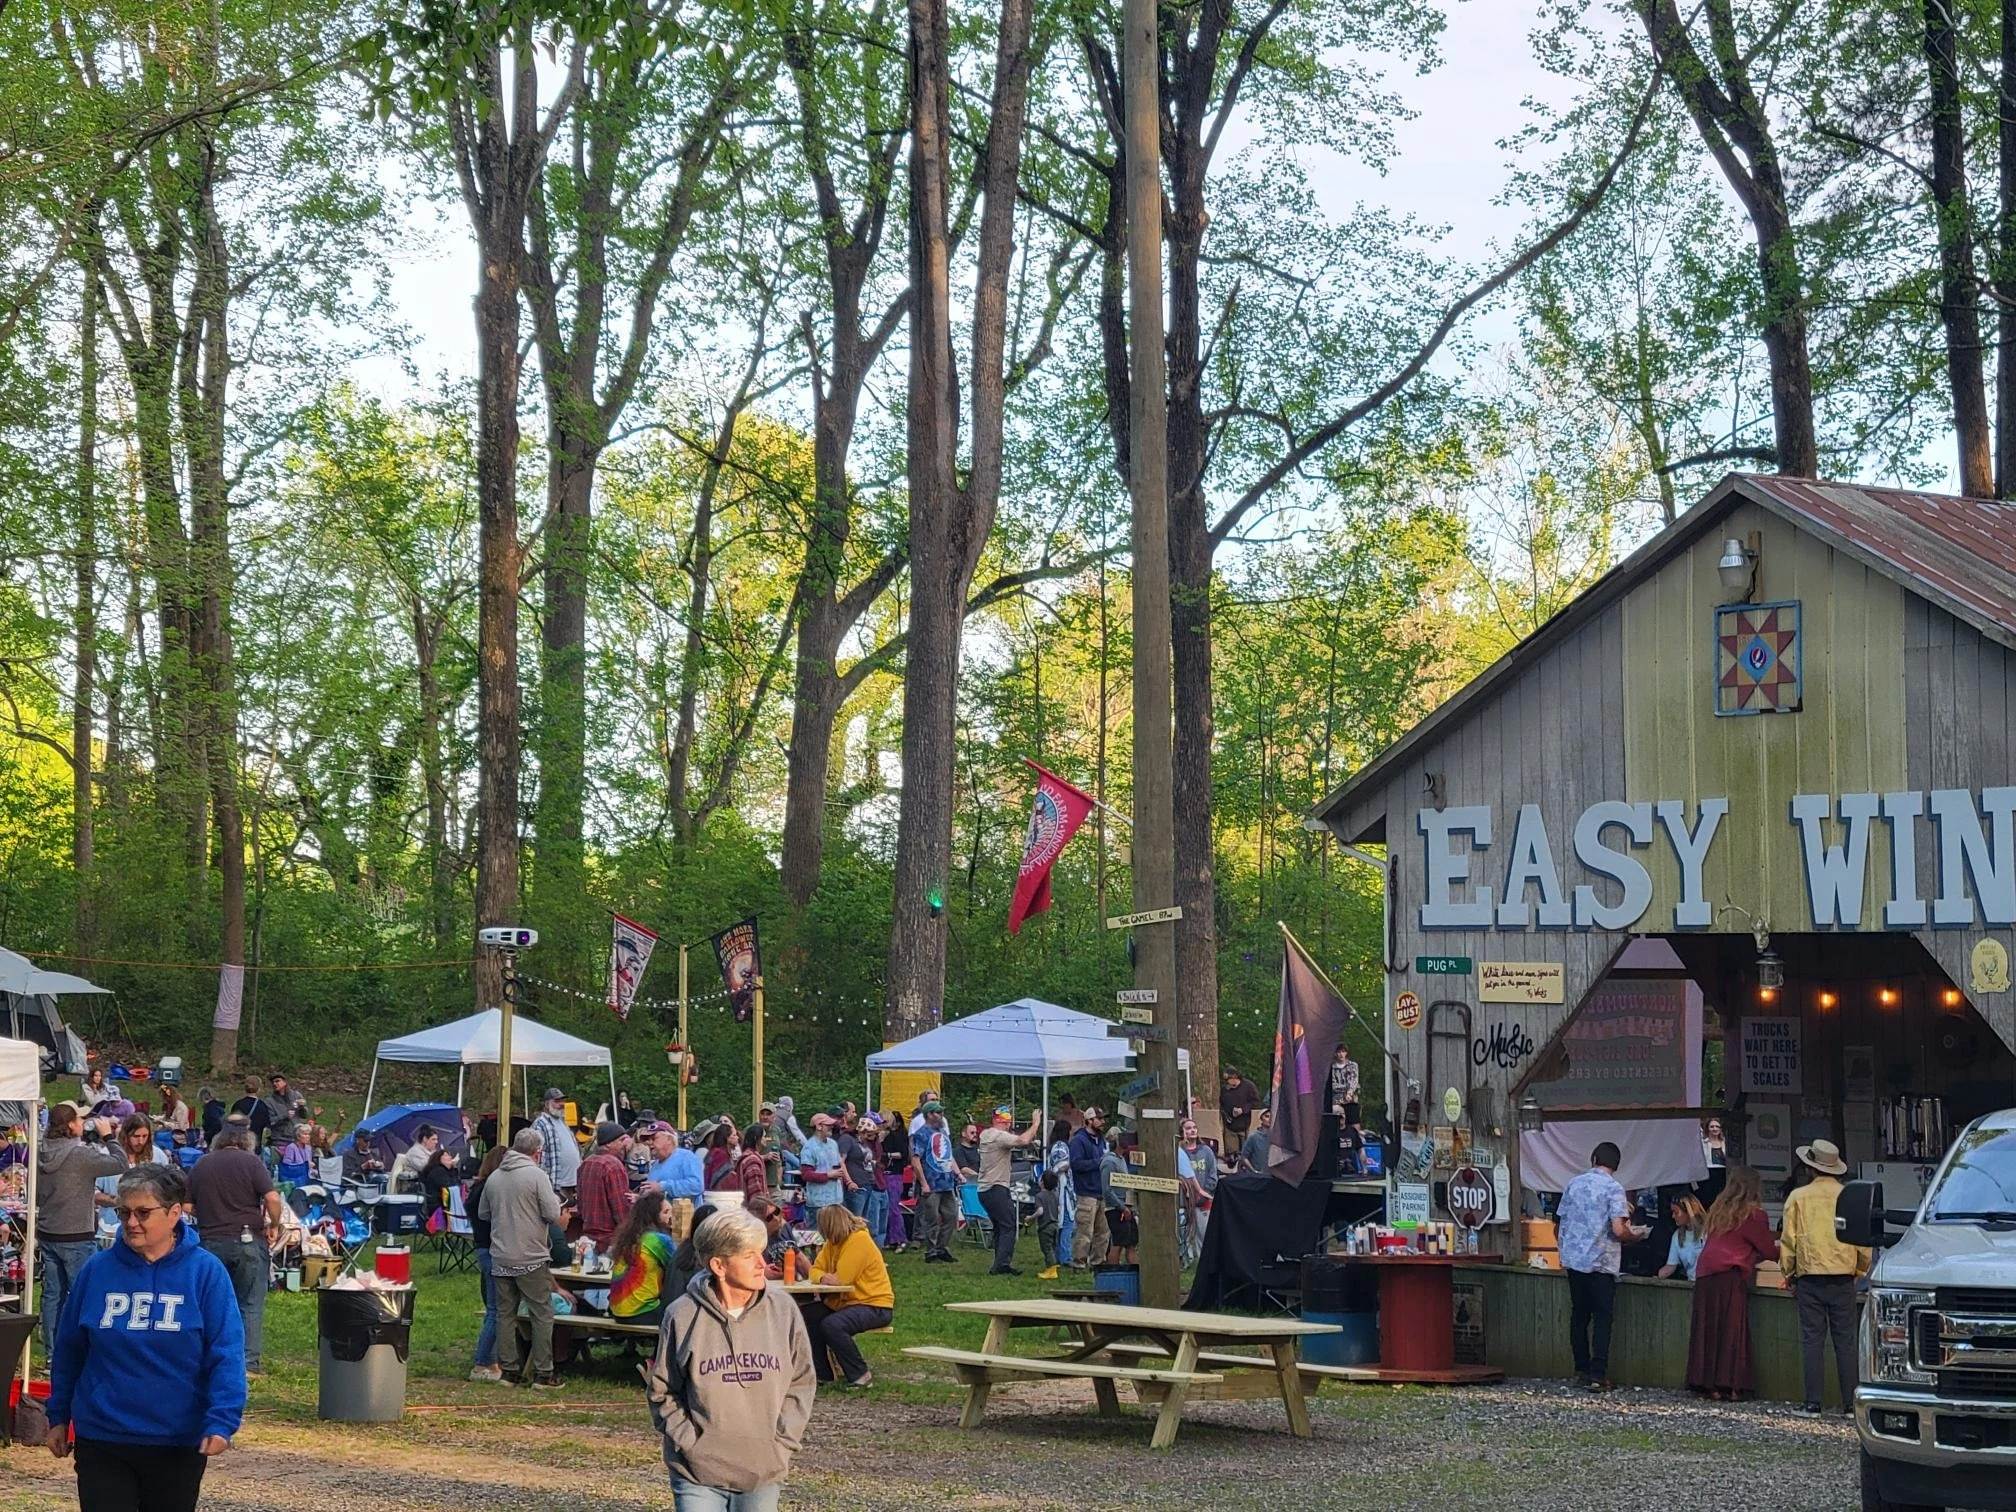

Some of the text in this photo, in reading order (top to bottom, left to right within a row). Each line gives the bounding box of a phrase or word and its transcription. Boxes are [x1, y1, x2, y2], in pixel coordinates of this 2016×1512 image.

[1053, 792, 1068, 824] FARM
[1035, 829, 1067, 867] VIRGINIA
[1418, 797, 1729, 931] EASY
[1130, 913, 1154, 924] CAMEL
[1427, 960, 1447, 972] PUG
[1397, 1006, 1419, 1020] BUST
[1752, 1022, 1789, 1036] TRUCKS
[1744, 1039, 1797, 1053] WAIT HERE
[1746, 1055, 1797, 1070] TO GET TO
[1752, 1072, 1790, 1087] SCALES
[1400, 1192, 1427, 1200] ASSIGNED
[1452, 1186, 1487, 1210] STOP
[1402, 1203, 1425, 1211] PARKING
[1406, 1214, 1421, 1222] ONLY
[100, 1292, 184, 1331] PEI
[699, 1353, 781, 1375] CAMP KEKOKA
